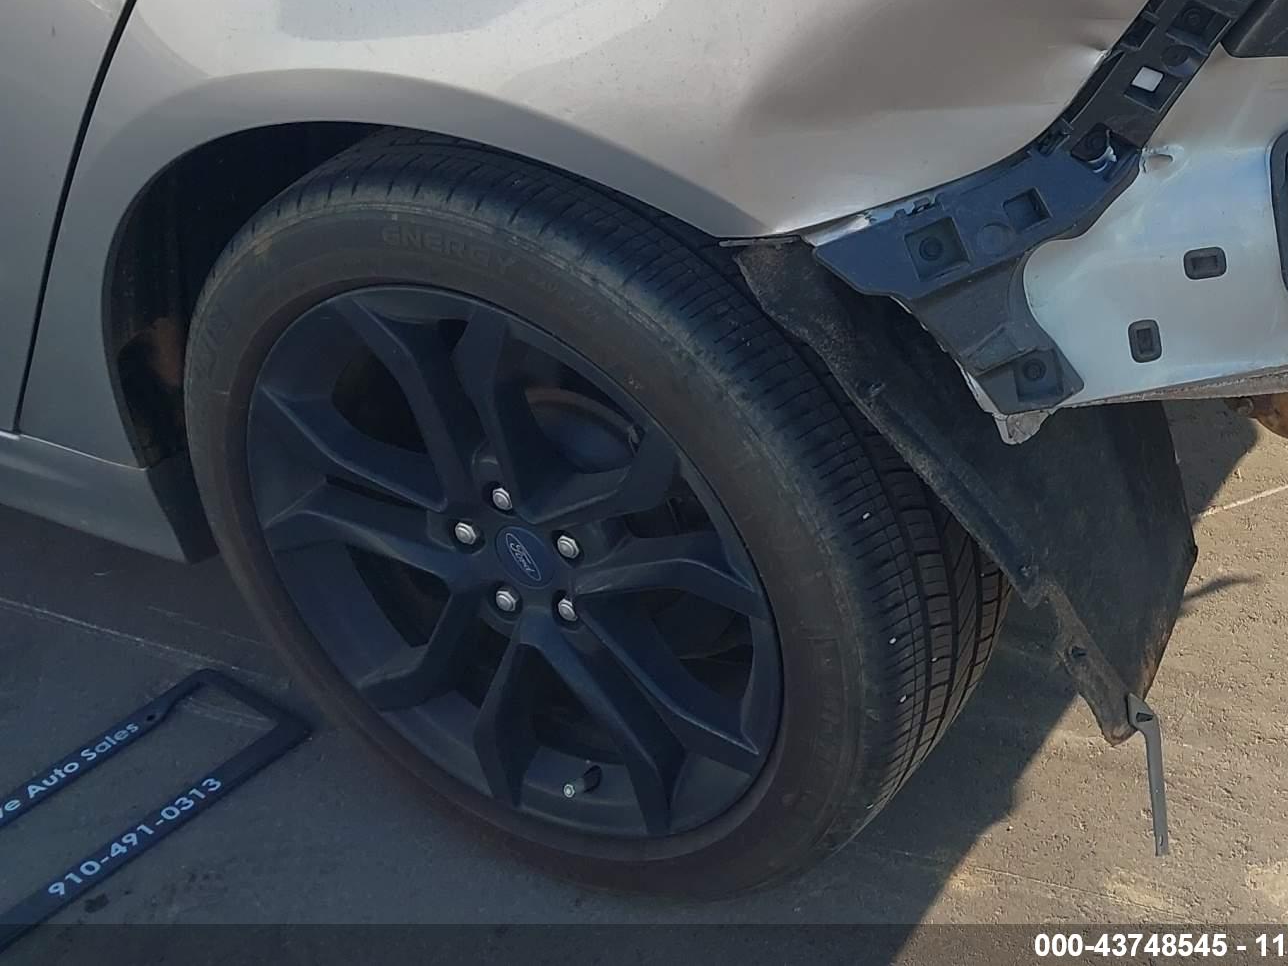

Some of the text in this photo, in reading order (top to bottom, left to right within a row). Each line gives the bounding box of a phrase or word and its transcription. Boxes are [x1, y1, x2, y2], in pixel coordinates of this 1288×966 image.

[27, 760, 79, 799] Auto
[81, 722, 140, 761] Sales
[47, 777, 223, 897] 910-491-0313
